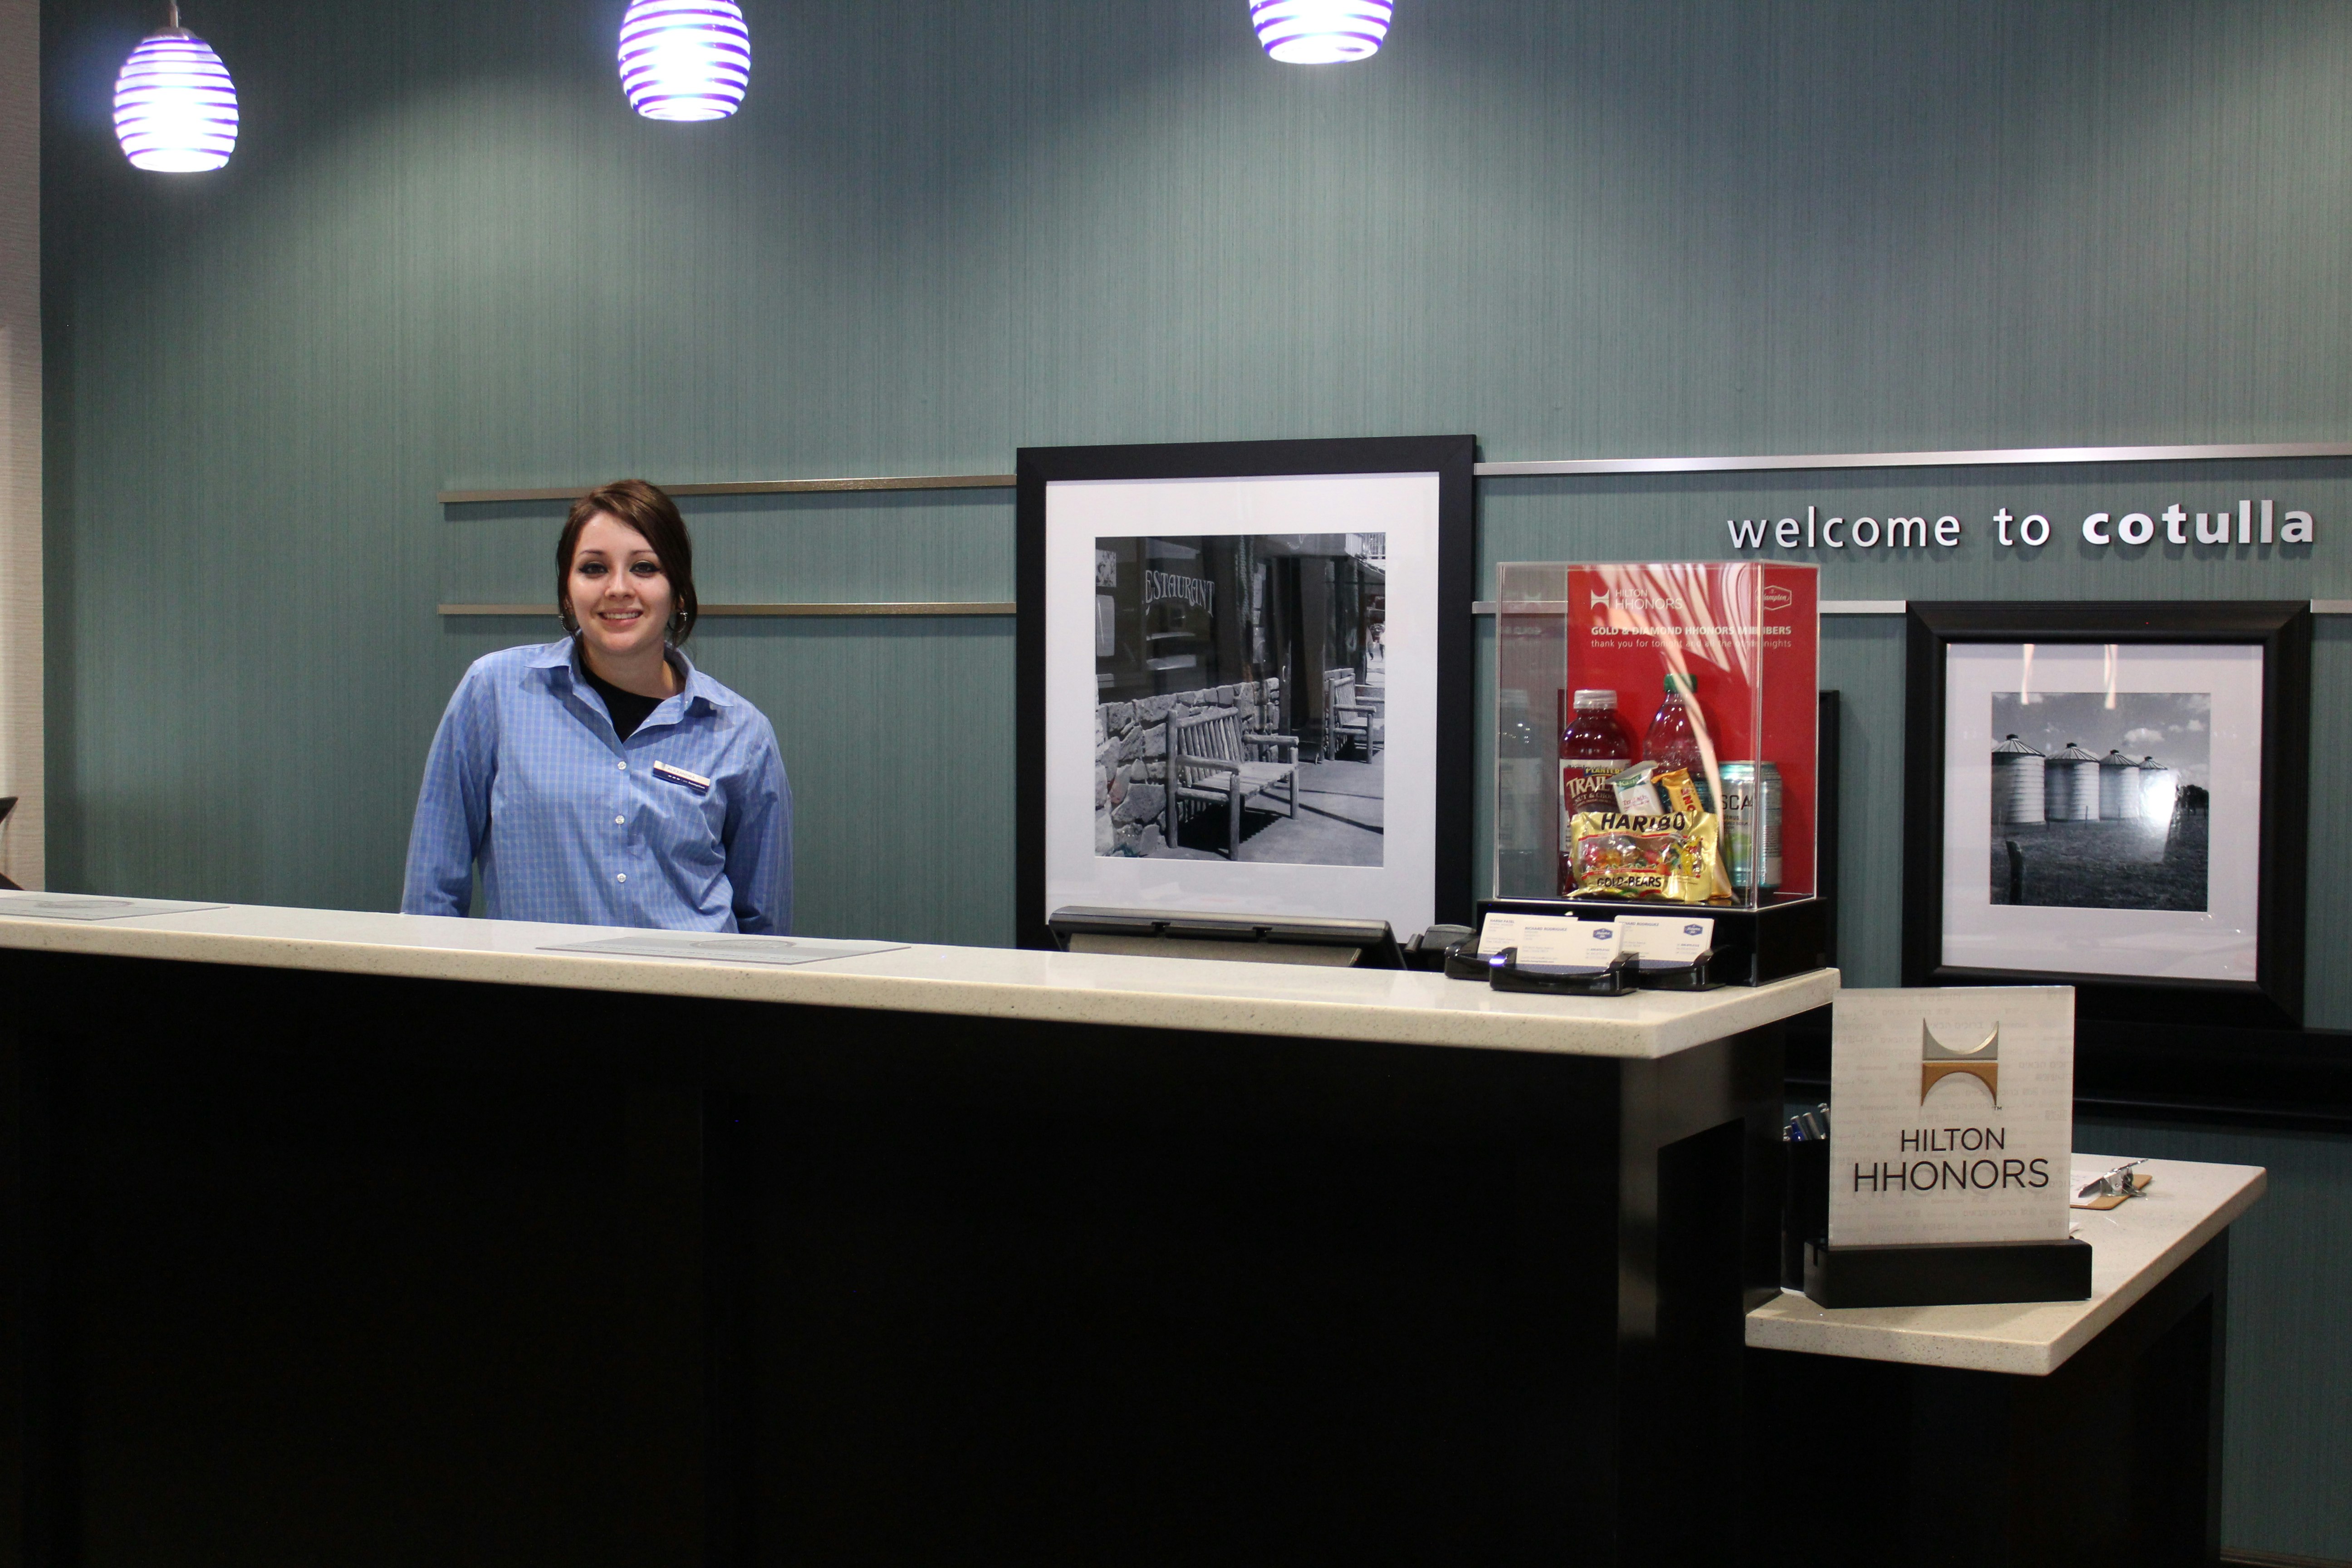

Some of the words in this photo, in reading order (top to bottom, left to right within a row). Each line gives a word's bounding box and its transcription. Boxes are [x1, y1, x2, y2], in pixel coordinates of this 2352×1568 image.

[1727, 505, 1961, 549] welcome
[1993, 507, 2050, 547] to
[2082, 500, 2314, 545] cotulla
[1142, 570, 1215, 618] ESTAURANT
[1616, 589, 1647, 597] HILTON
[1763, 593, 1790, 602] ampton
[1616, 598, 1683, 609] HHONORS
[1591, 626, 1619, 635] GOLD
[1622, 627, 1629, 635] &
[1632, 626, 1682, 635] DIAMOND
[1685, 626, 1735, 635] HHONORS
[1636, 639, 1649, 647] for
[1764, 638, 1792, 649] nights
[1601, 812, 1685, 833] HARIBO
[1597, 876, 1661, 888] GOLD-BEARS
[1901, 1127, 2005, 1152] HILTON
[1854, 1158, 2049, 1192] HHONORS
